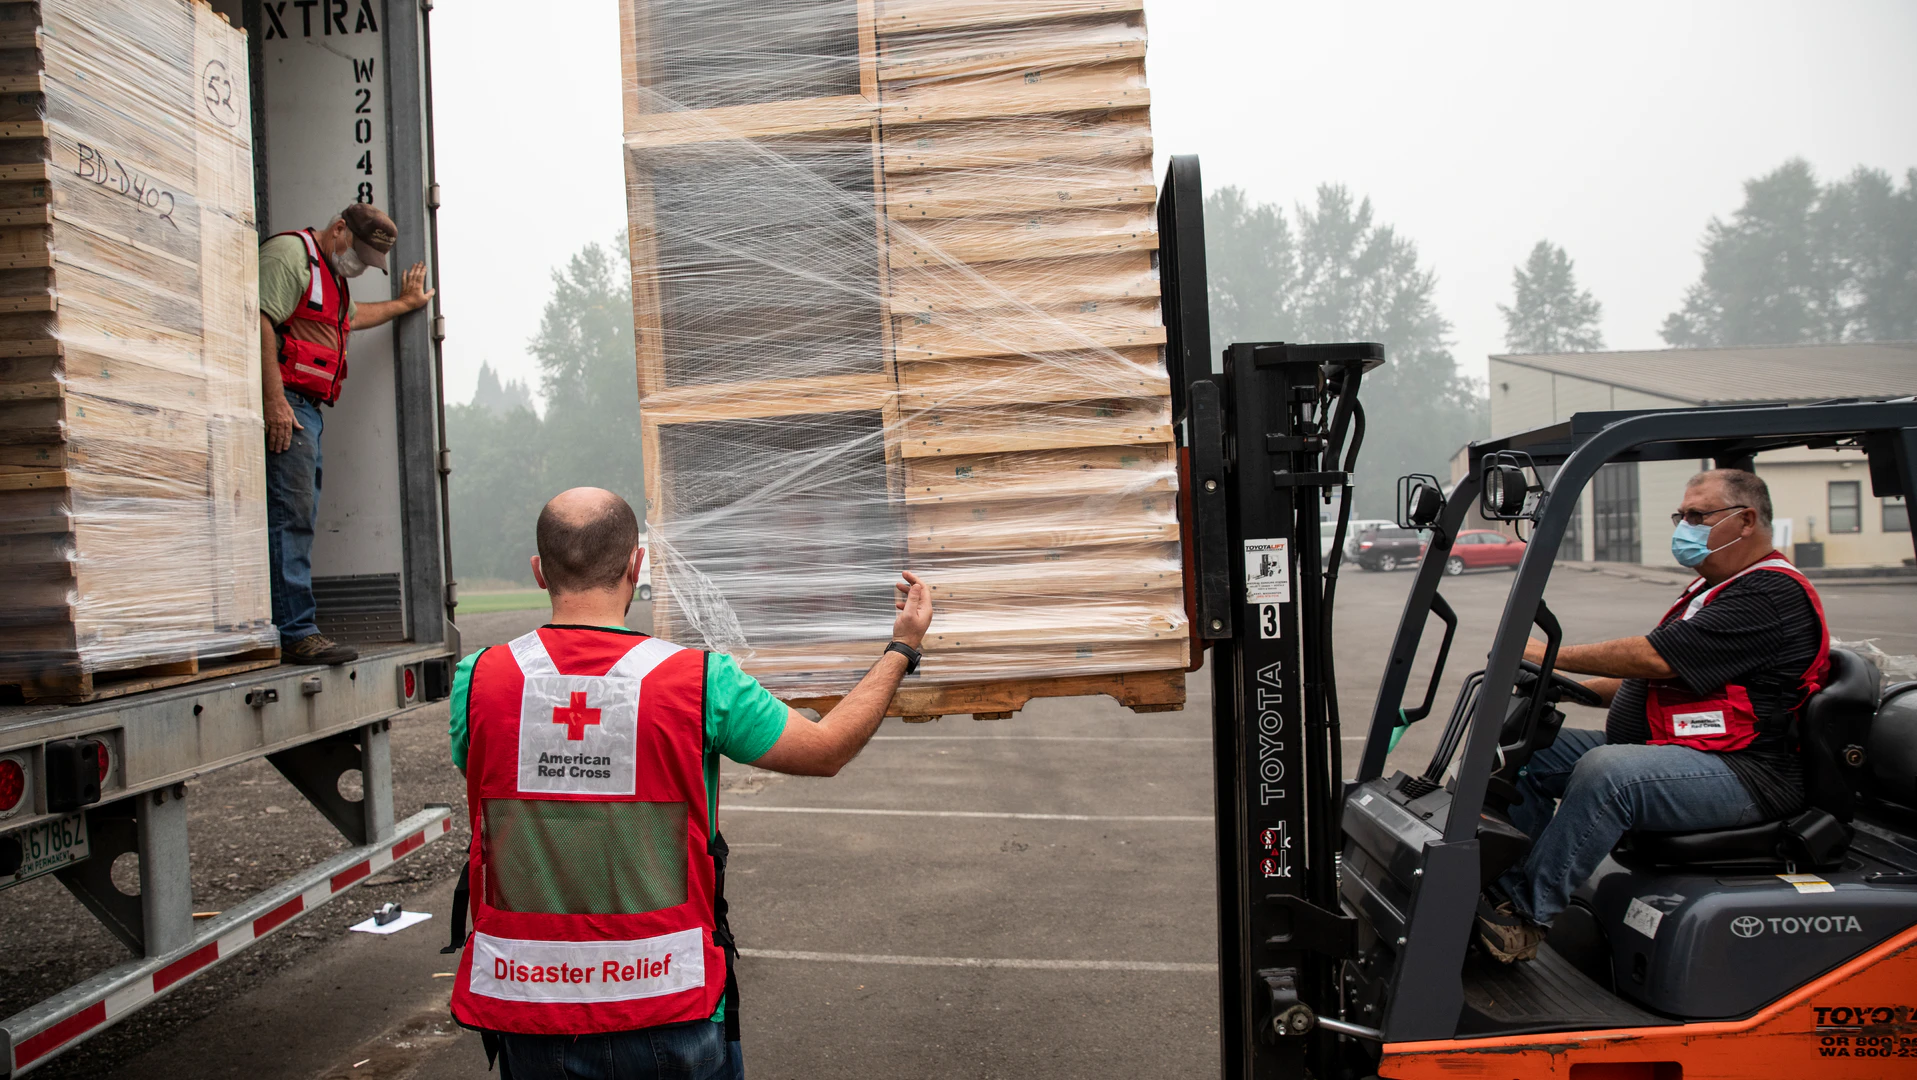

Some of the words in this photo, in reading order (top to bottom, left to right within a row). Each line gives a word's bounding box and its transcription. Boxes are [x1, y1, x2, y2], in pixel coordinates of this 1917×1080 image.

[263, 0, 378, 40] XTRA
[206, 76, 235, 114] 52
[353, 58, 374, 205] W2048
[74, 142, 180, 232] BD-D402
[1263, 604, 1277, 637] 3
[1257, 661, 1285, 805] TOYOTA
[537, 765, 565, 777] Red
[569, 766, 611, 778] Cross
[538, 752, 611, 765] American
[30, 814, 83, 859] 6786Z
[35, 850, 70, 870] PERMANENT
[1767, 916, 1863, 934] TOYOTA
[494, 957, 596, 984] Disaster
[602, 953, 672, 983] Relief
[1818, 1047, 1850, 1057] WA
[1821, 1036, 1850, 1046] OR
